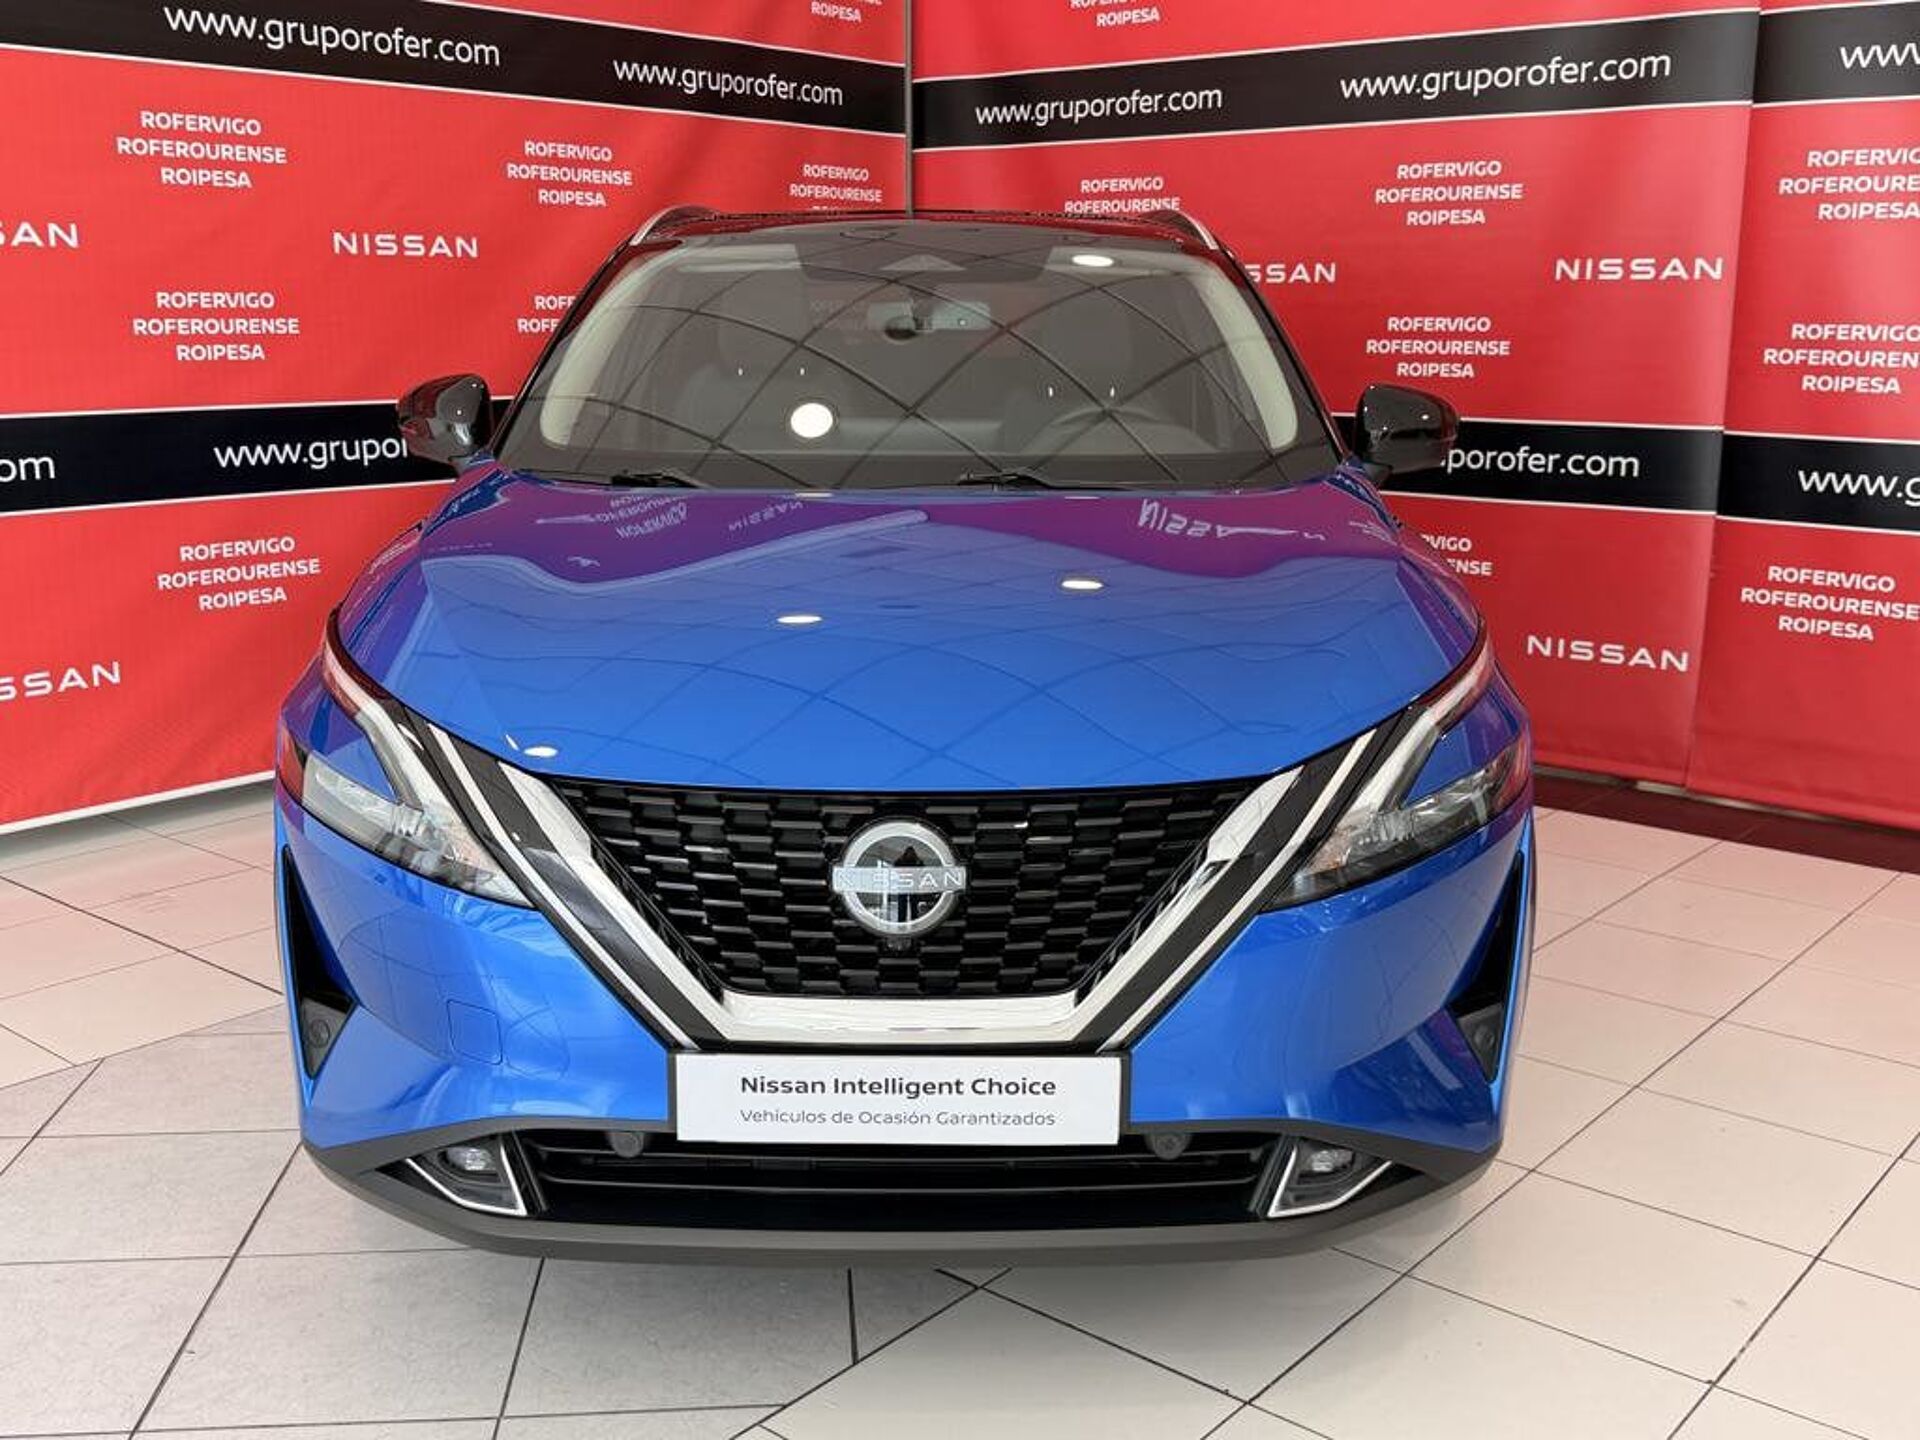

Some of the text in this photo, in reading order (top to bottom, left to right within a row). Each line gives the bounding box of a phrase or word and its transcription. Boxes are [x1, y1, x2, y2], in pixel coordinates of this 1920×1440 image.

[810, 1, 862, 22] ROIPESA
[1096, 6, 1160, 27] ROIPESA
[163, 6, 500, 67] www.gruporofer.com
[613, 59, 844, 107] www.gruporofer.com
[1340, 51, 1672, 100] www.gruporofer.com
[975, 89, 1222, 127] www.gruporofer.com
[140, 110, 262, 136] ROFERVIGO
[116, 136, 288, 164] ROFEROURENSE
[524, 139, 613, 162] ROFERVIGO
[160, 167, 252, 188] ROIPESA
[506, 162, 633, 186] ROFEROURENSE
[803, 164, 869, 181] ROFERVIGO
[1396, 160, 1502, 180] ROFERVIGO
[789, 183, 882, 203] ROFEROURENSE
[1080, 176, 1164, 193] ROFERVIGO
[1375, 183, 1524, 204] ROFEROURENSE
[538, 188, 607, 207] ROIPESA
[1064, 197, 1180, 214] ROFEROURENSE
[1406, 208, 1486, 226] ROIPESA
[1818, 201, 1920, 220] ROIPESA
[0, 221, 79, 248] AN
[333, 232, 478, 258] NISSAN
[1555, 256, 1724, 281] NISSAN
[156, 291, 275, 309] ROFERVIGO
[132, 317, 300, 335] ROFEROURENSE
[1387, 316, 1492, 333] ROFERVIGO
[1791, 323, 1920, 342] ROFERVIGO
[175, 343, 265, 361] ROIPESA
[1366, 339, 1511, 356] ROFEROURENSE
[1396, 361, 1475, 378] ROIPESA
[1802, 374, 1902, 394] ROIPESA
[1439, 445, 1640, 477] porofer.com
[179, 536, 295, 563] ROFERVIGO
[157, 558, 321, 591] ROFEROURENSE
[1767, 565, 1896, 593] ROFERVIGO
[198, 586, 288, 611] ROIPESA
[1740, 586, 1920, 622] ROFEROURENSE
[1778, 615, 1876, 641] ROIPESA
[1527, 635, 1689, 673] NISSAN
[740, 1075, 1057, 1100] Nissan Intelligent Choice
[830, 1109, 854, 1124] de
[857, 1110, 932, 1125] Ocasión
[935, 1111, 1056, 1126] Garantizados
